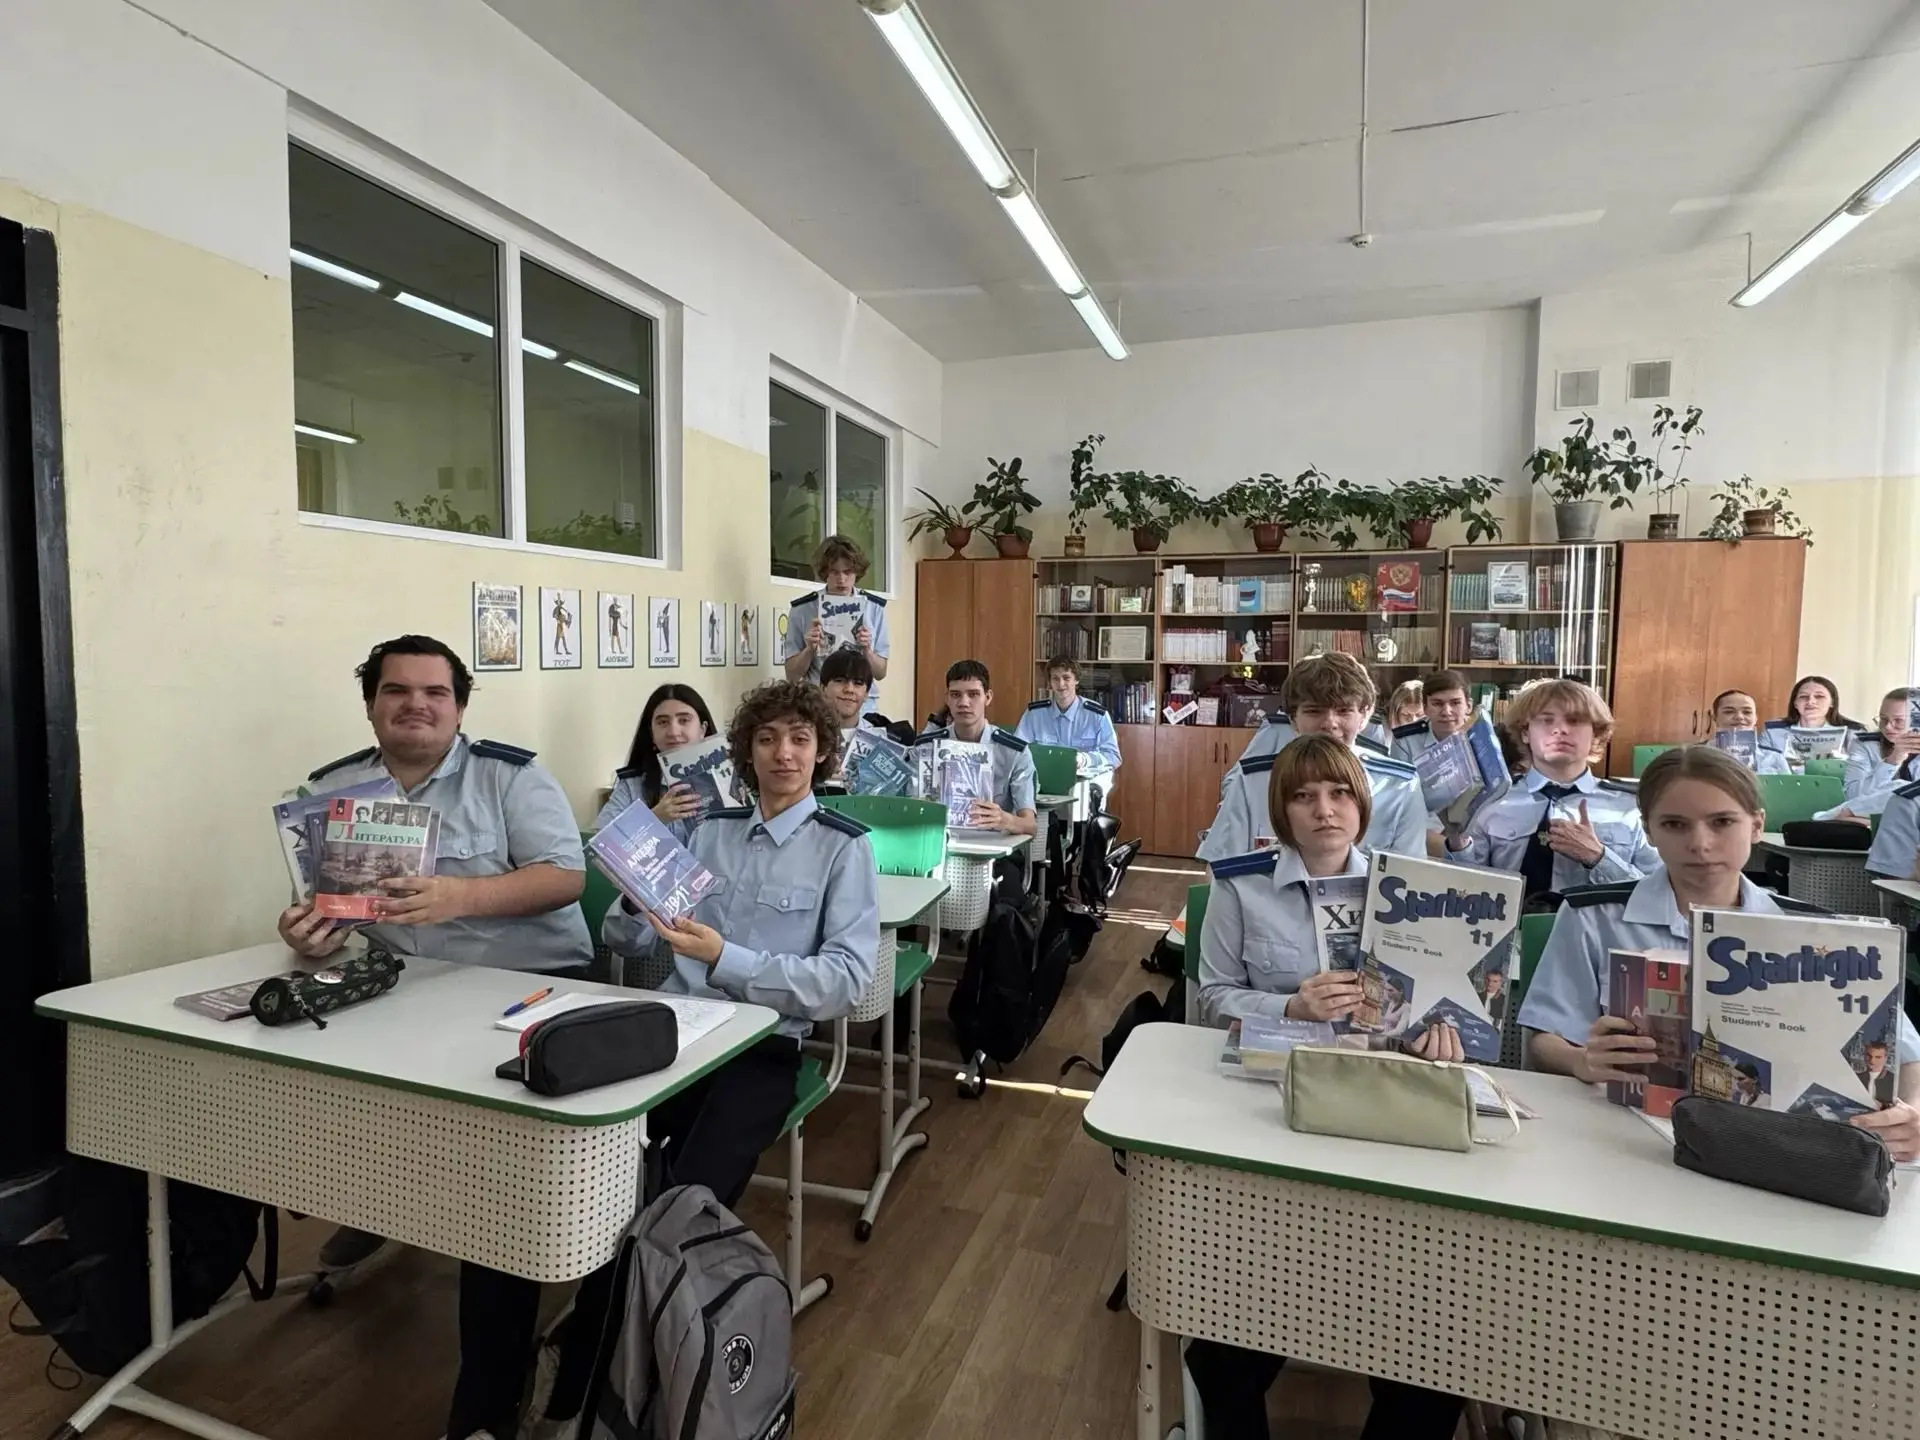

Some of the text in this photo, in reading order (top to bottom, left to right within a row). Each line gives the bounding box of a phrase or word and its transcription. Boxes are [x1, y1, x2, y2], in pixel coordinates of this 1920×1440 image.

[335, 823, 421, 845] ЛИТЕРАТУРА
[1374, 876, 1507, 925] Starlight
[1469, 929, 1493, 947] 11
[1423, 948, 1443, 957] Book
[1706, 936, 1883, 996] Starlight
[1837, 993, 1869, 1015] 11
[1721, 1014, 1806, 1033] Student's Book
